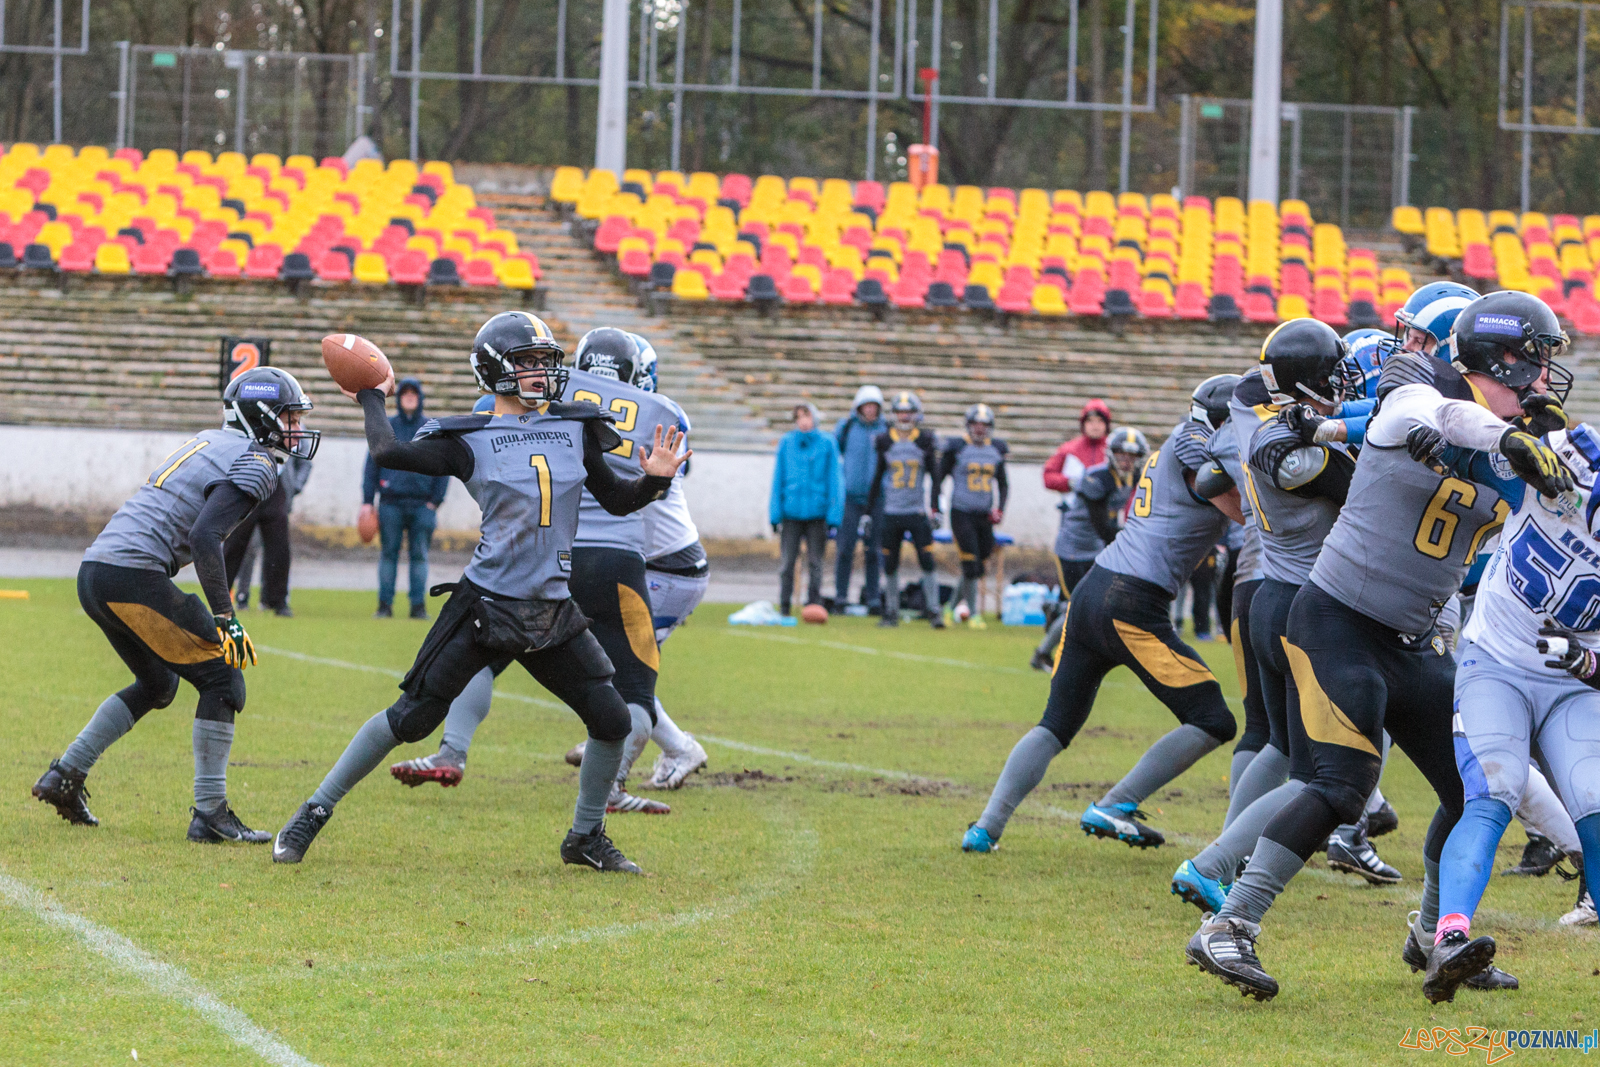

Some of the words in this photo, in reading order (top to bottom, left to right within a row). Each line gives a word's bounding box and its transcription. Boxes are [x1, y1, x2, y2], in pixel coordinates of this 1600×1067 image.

[1479, 316, 1519, 327] PRIMACOL
[229, 343, 260, 381] 2
[490, 431, 574, 454] LOWLANDERS
[890, 460, 919, 489] 27
[530, 453, 554, 528] 1
